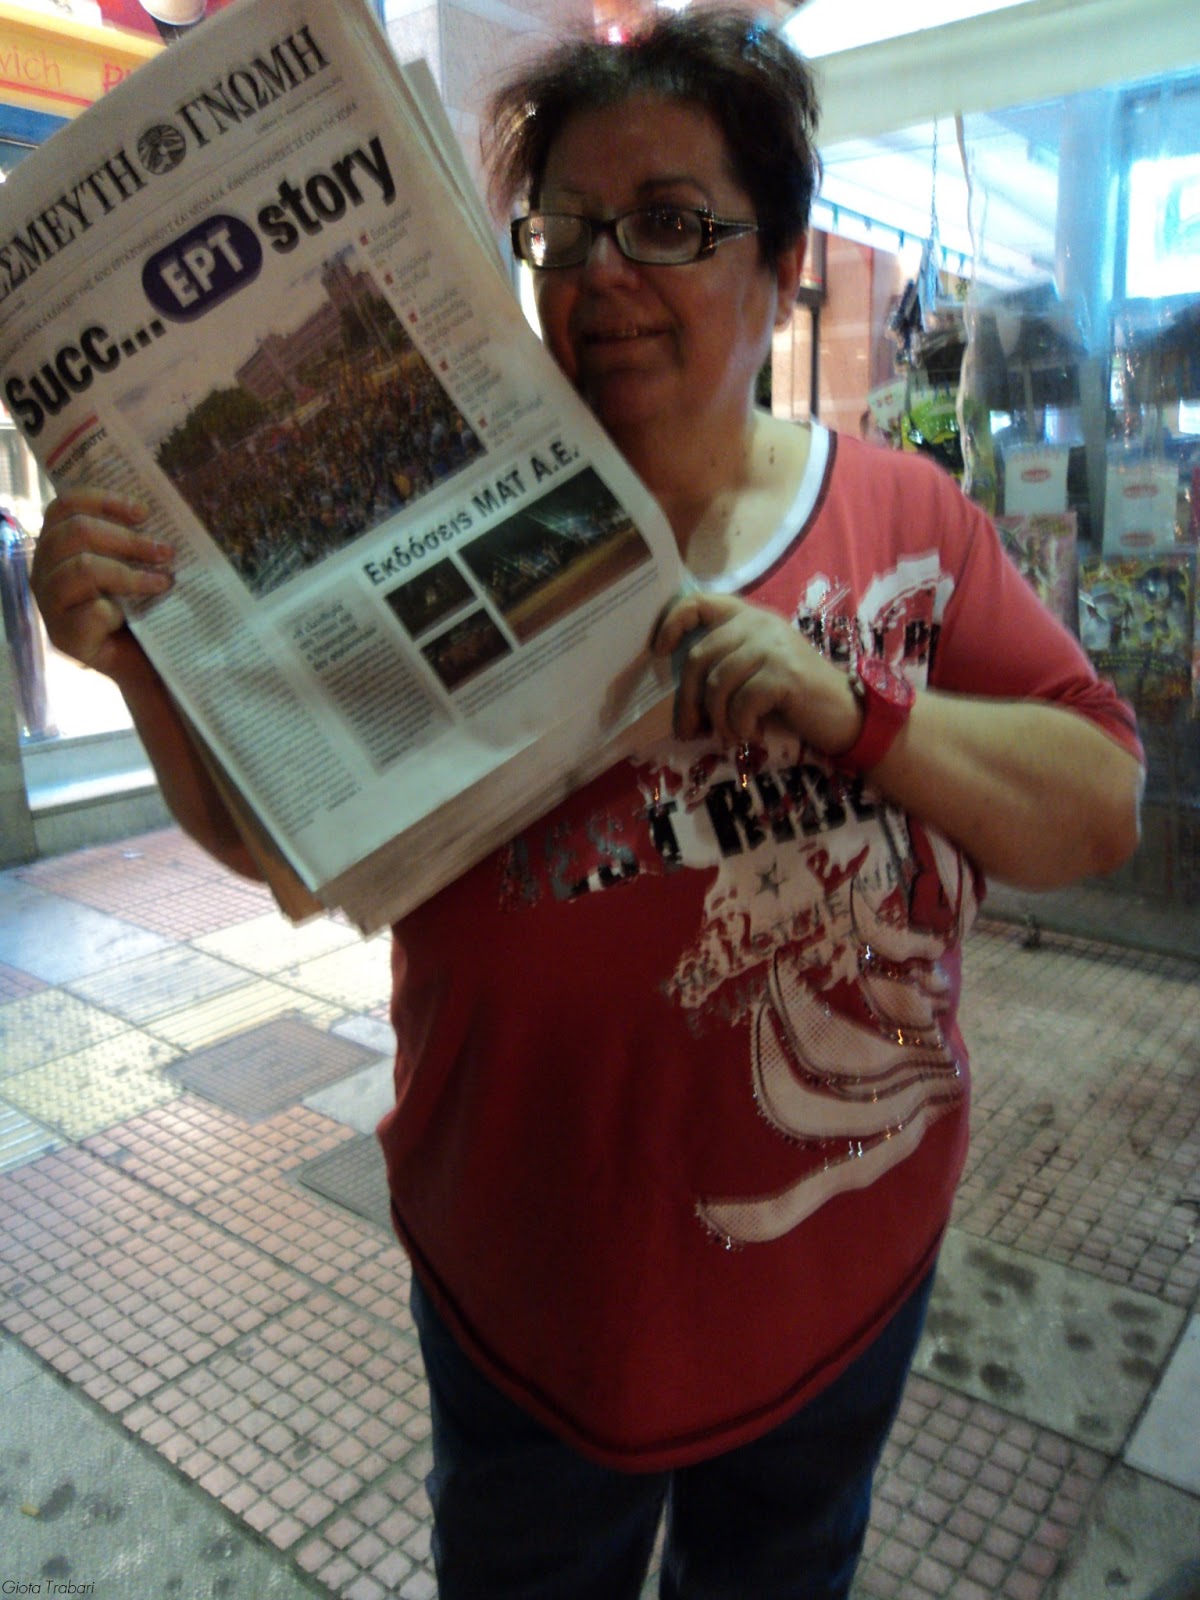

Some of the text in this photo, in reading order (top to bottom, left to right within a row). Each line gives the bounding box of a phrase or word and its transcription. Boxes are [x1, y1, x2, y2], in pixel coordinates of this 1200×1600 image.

[103, 63, 133, 93] P
[0, 149, 148, 303] ΣΜΕΥΤΗ
[175, 25, 330, 148] ΓΝΩΜΗ
[257, 135, 397, 254] story
